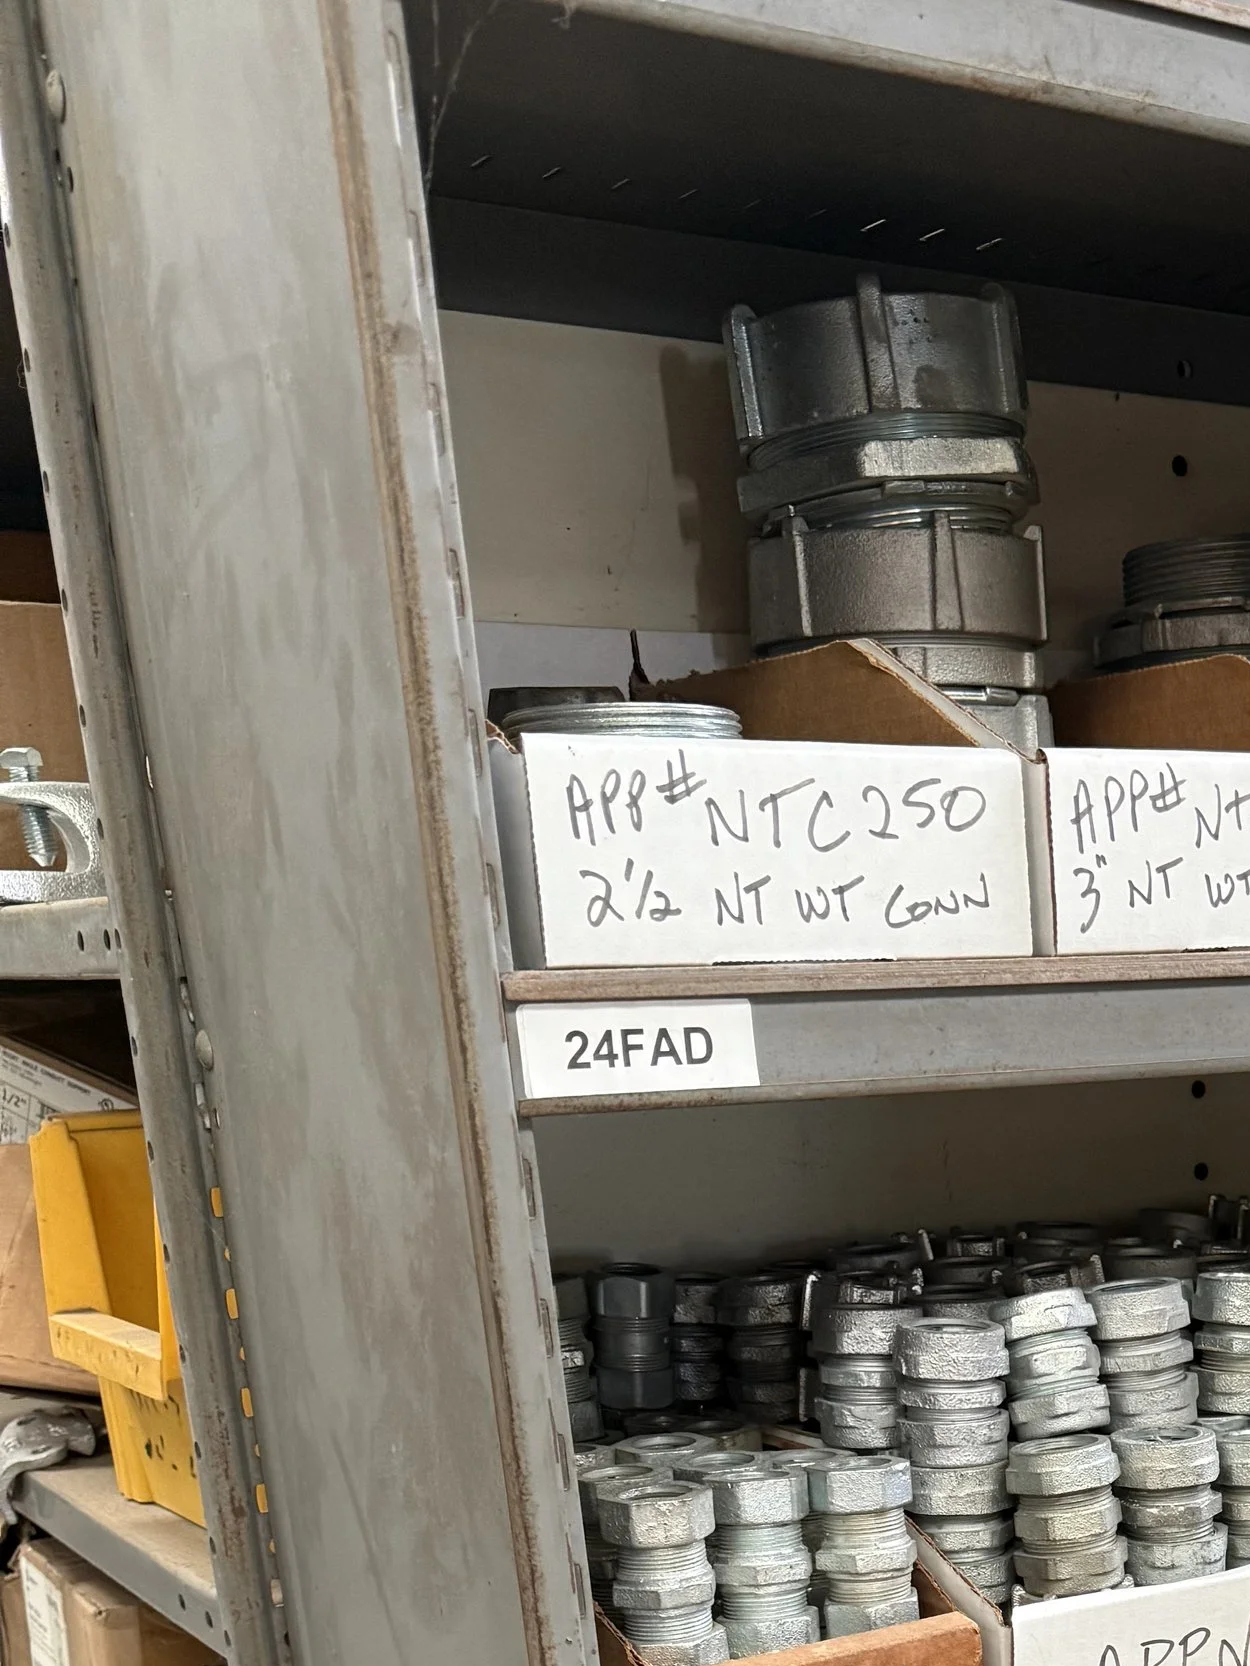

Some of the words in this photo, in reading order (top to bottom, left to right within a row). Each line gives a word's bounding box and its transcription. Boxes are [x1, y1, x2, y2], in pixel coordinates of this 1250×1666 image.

[705, 776, 987, 853] NTC250
[715, 870, 771, 927] NT
[794, 874, 866, 924] WT
[885, 871, 990, 929] CONN
[1126, 855, 1184, 910] NT
[566, 1025, 714, 1072] 24FAD
